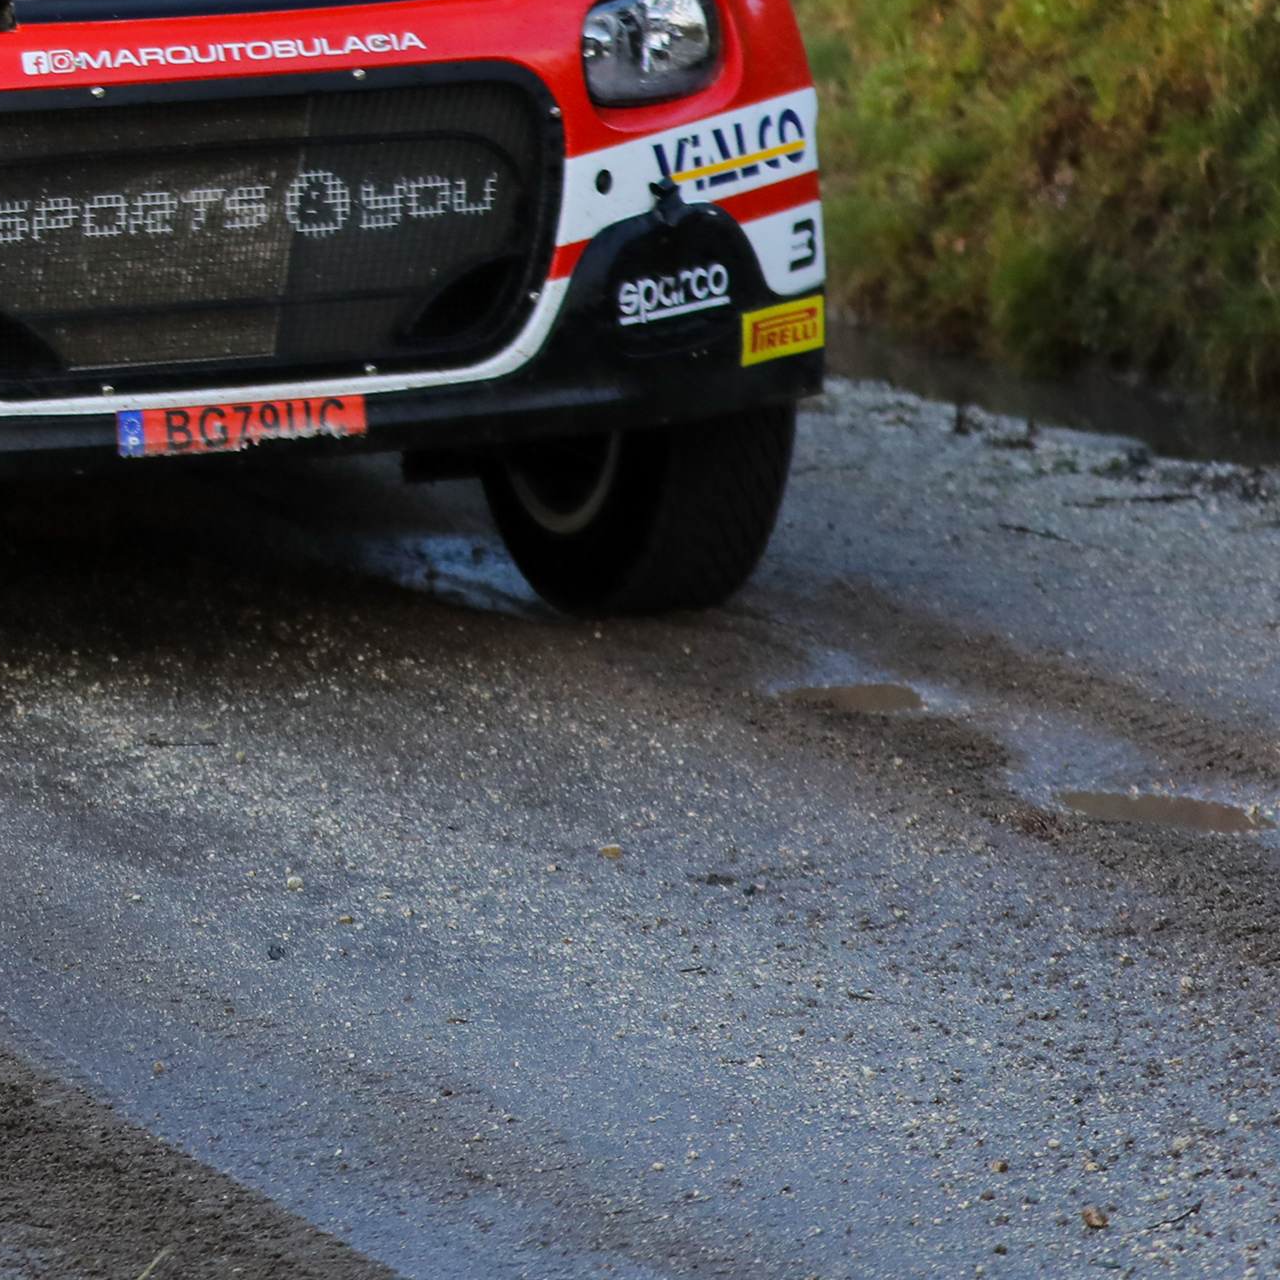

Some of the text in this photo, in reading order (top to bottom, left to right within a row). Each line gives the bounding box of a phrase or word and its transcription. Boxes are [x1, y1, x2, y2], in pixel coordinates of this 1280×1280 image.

[80, 31, 426, 70] MARQUITOBULACIA
[619, 263, 730, 324] sparco
[751, 306, 819, 354] PIRELLI
